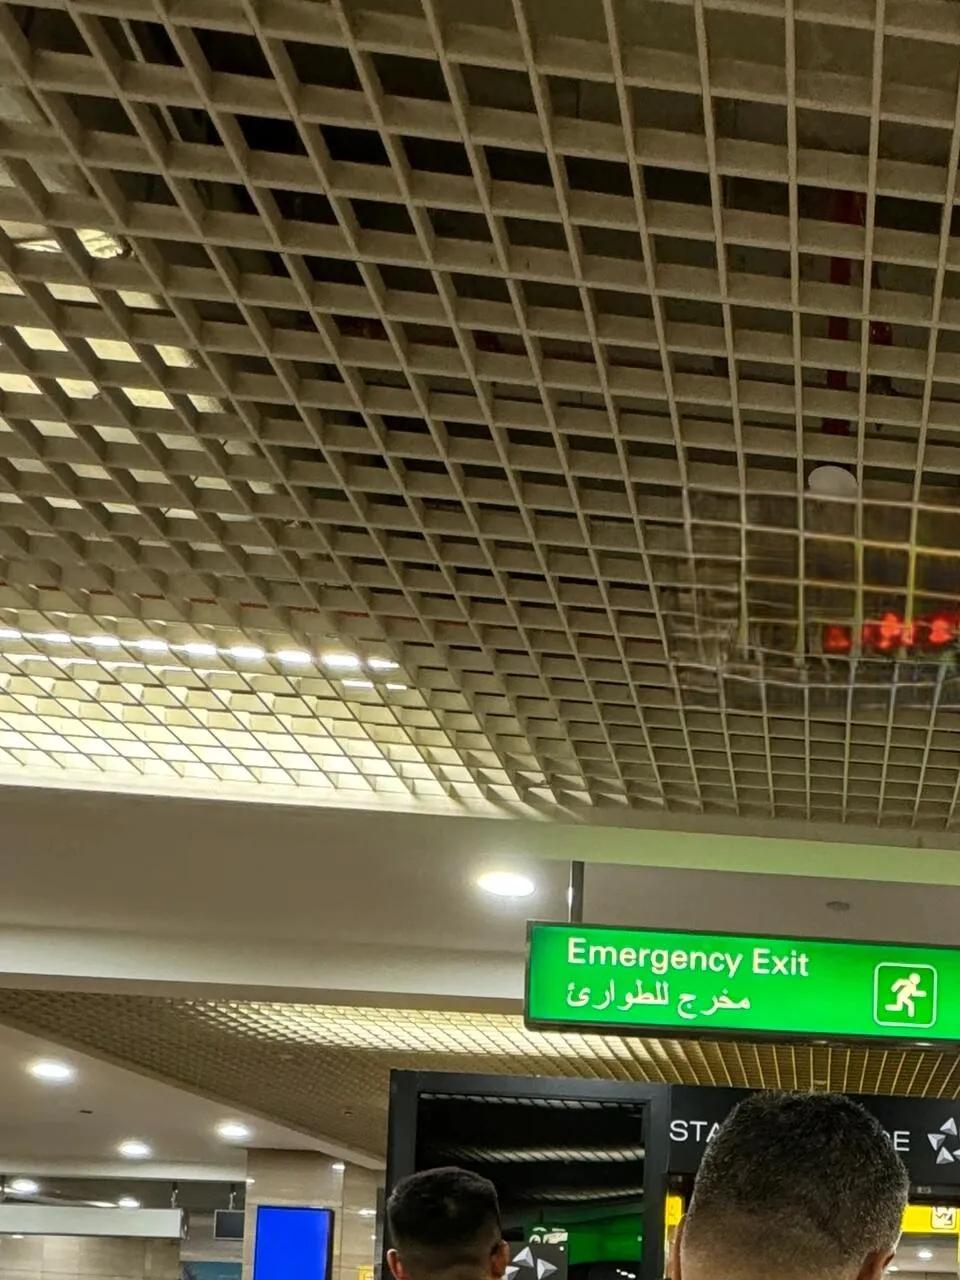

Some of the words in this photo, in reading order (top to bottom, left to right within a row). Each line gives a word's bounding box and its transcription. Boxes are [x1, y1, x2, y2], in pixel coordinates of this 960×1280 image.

[567, 937, 743, 978] Emergency
[752, 947, 809, 977] Exit
[566, 978, 669, 1010] للطوارئ
[677, 987, 750, 1019] مخرج
[669, 1119, 721, 1143] STA
